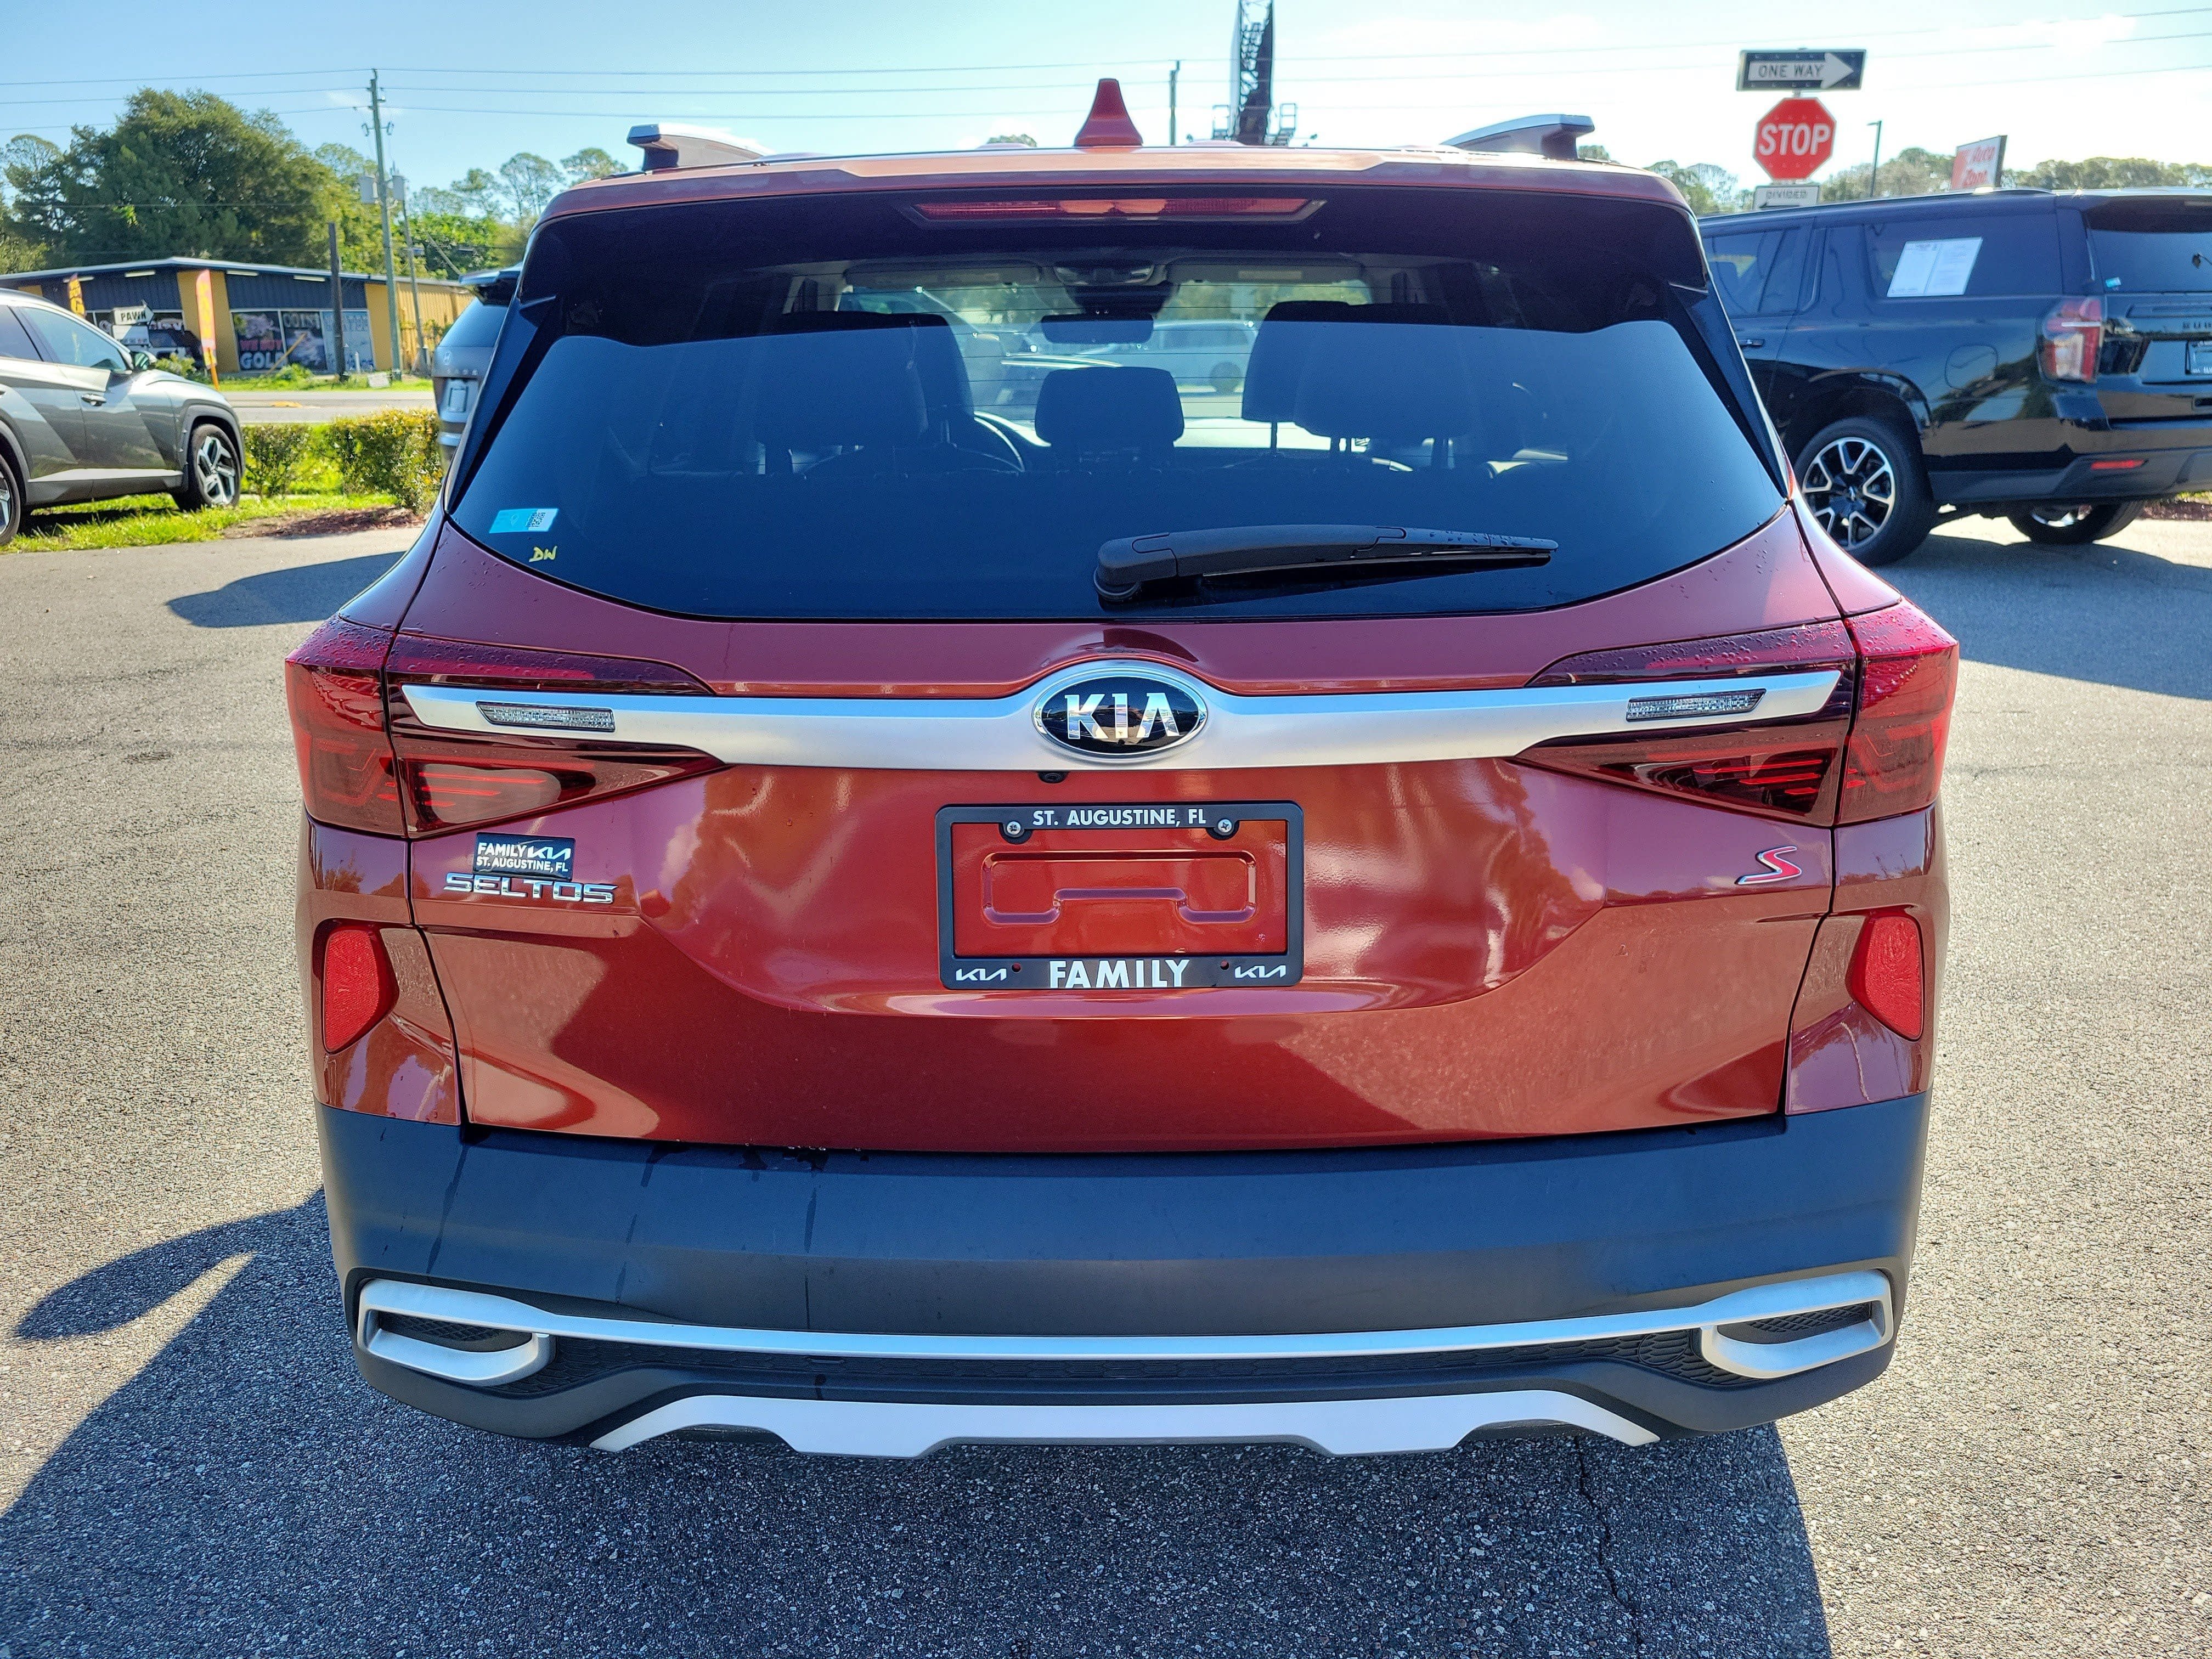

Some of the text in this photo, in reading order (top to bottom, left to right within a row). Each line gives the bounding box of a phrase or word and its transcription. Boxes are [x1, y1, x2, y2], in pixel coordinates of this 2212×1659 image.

[1758, 64, 1824, 78] ONE WAY
[1758, 123, 1830, 156] STOP
[1765, 189, 1807, 199] DIVIDED
[121, 311, 146, 321] PAWN
[240, 352, 286, 369] GOLD
[528, 545, 557, 562] DW
[1064, 692, 1180, 740] KIA
[1032, 809, 1206, 827] ST. AUGUSTINE, FL
[477, 843, 571, 860] FAMILY KIA
[476, 858, 568, 873] ST. AUGUSTINE, FL
[1735, 845, 1802, 885] S
[443, 872, 618, 904] SELTOS
[956, 959, 1286, 988] KIA FAMILY KIA
